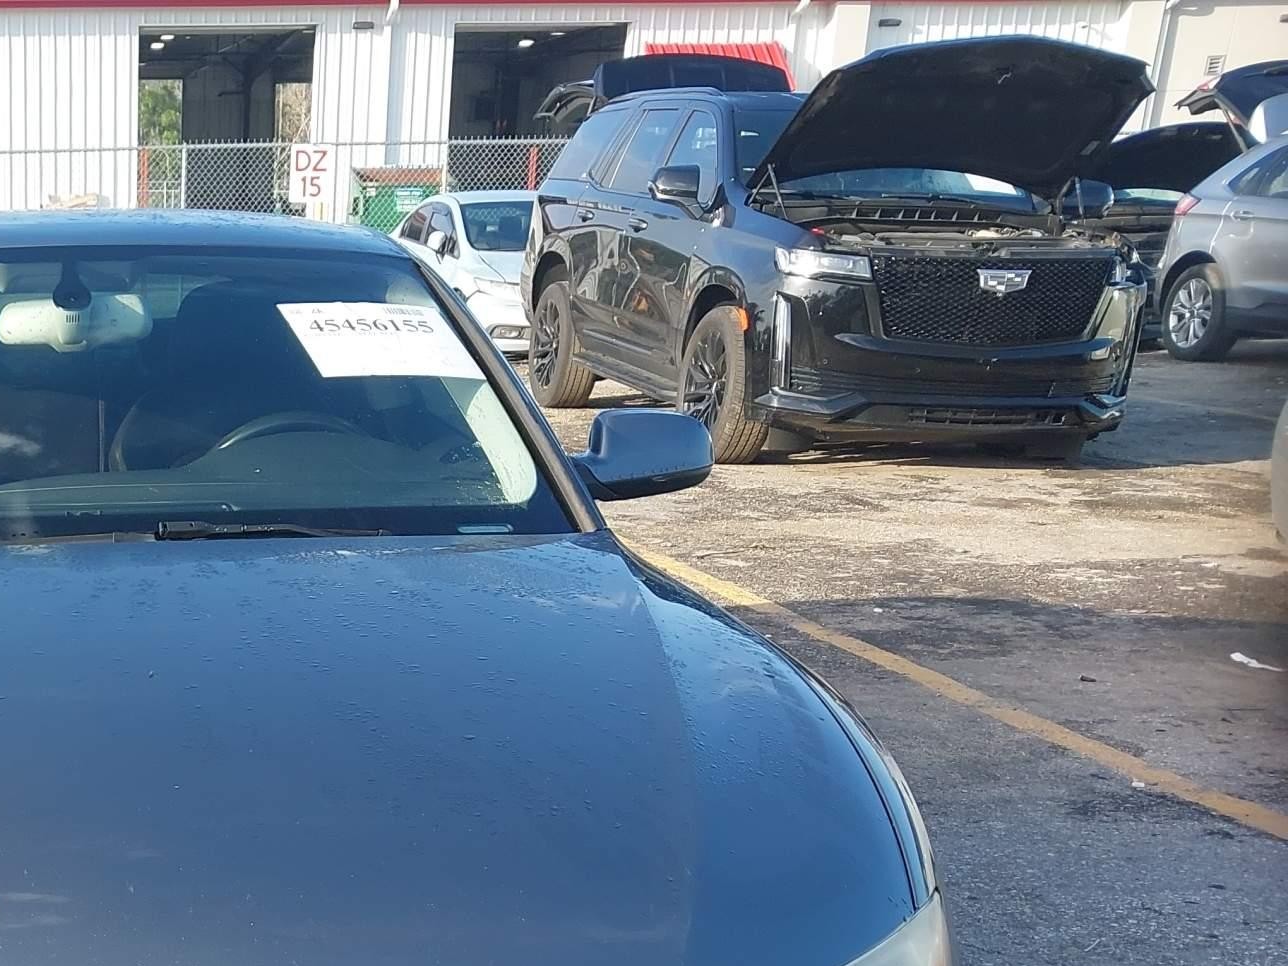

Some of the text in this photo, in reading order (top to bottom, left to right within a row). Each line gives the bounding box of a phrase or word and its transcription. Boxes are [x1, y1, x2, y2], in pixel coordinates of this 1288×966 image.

[295, 150, 327, 172] DZ
[301, 175, 321, 197] 15
[309, 318, 434, 334] 45456155
